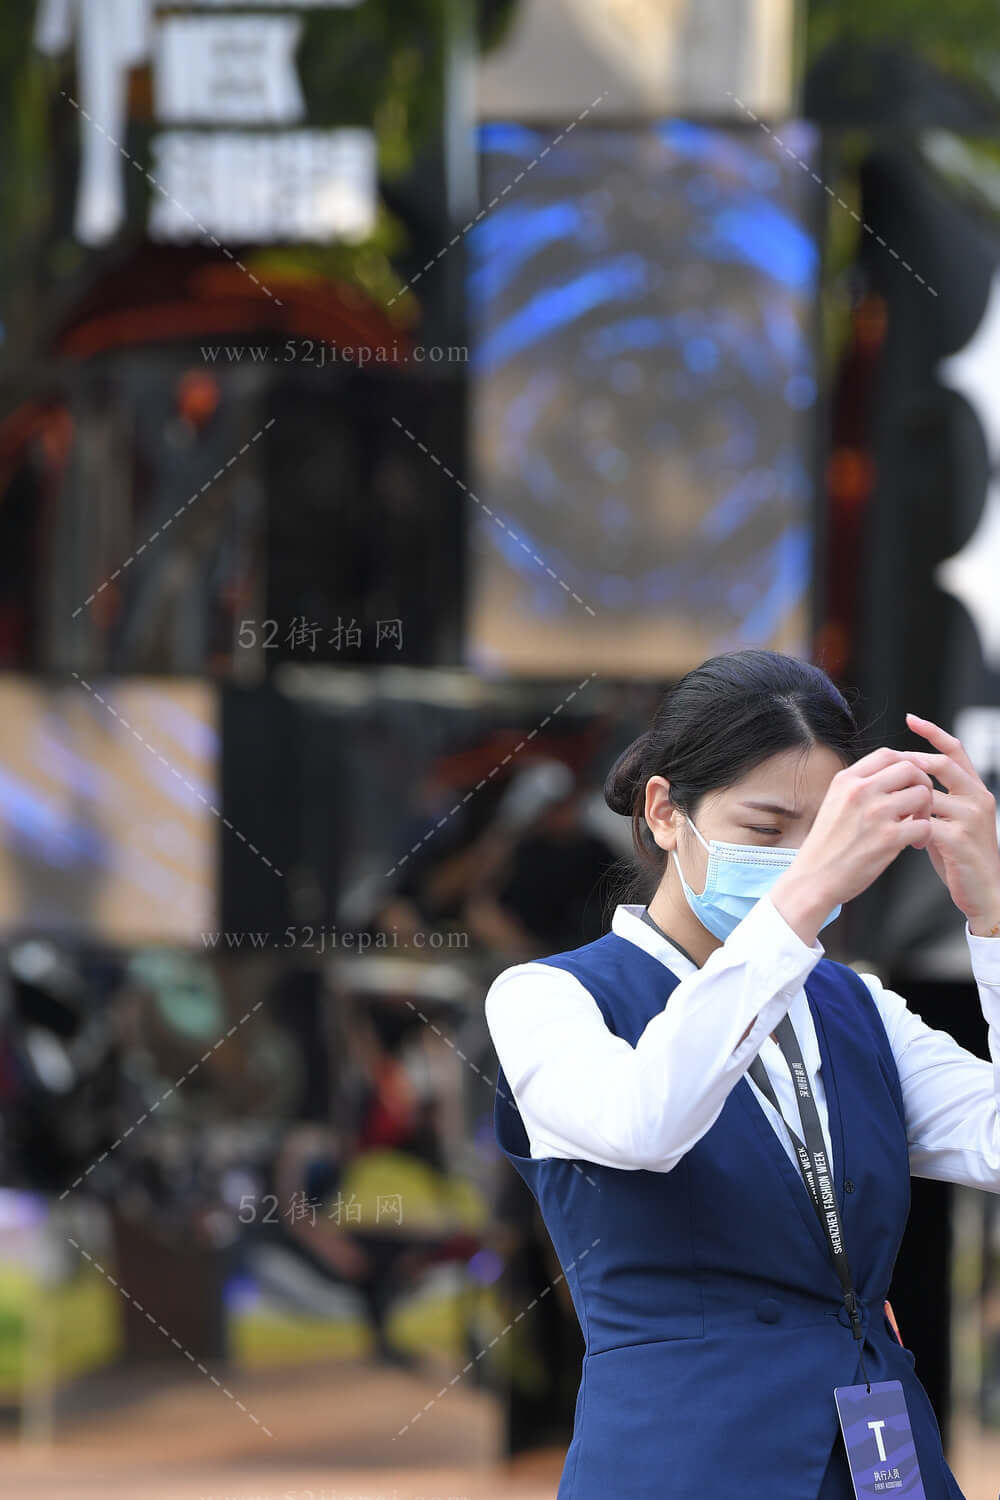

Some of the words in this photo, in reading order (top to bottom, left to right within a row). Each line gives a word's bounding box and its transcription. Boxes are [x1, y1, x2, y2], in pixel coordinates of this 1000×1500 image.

[797, 1146, 811, 1170] WEEK
[812, 1151, 828, 1174] WEEK
[817, 1175, 836, 1210] FASHION
[825, 1211, 842, 1254] SHENZHEN
[867, 1420, 887, 1462] T
